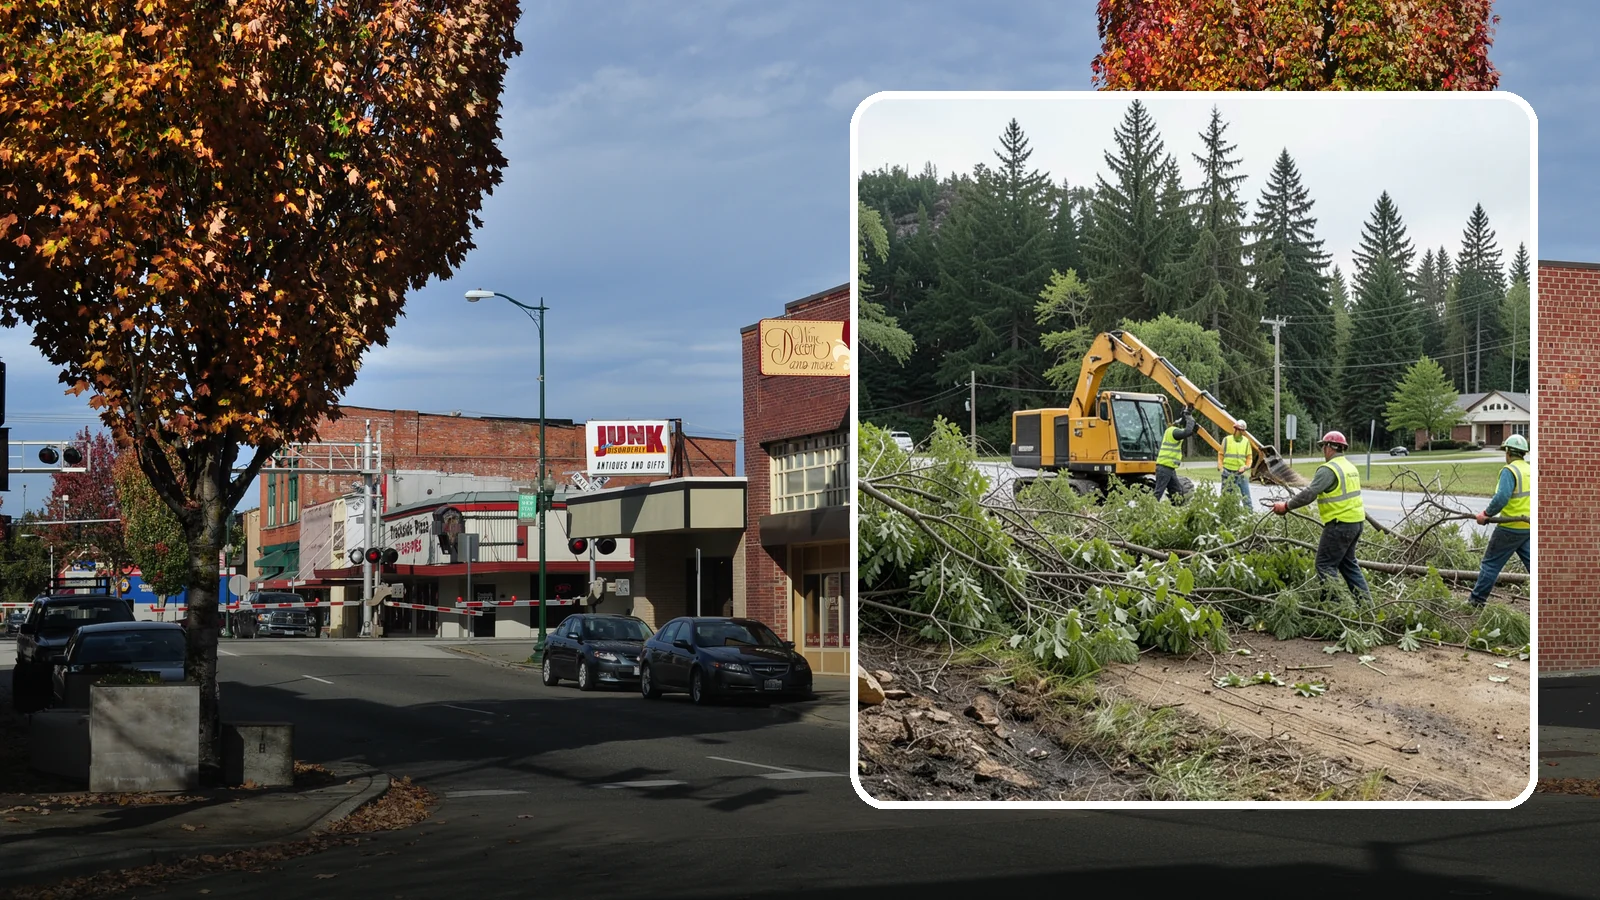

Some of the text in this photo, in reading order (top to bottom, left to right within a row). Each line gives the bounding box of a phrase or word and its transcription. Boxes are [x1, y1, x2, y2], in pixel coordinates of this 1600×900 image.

[595, 425, 665, 457] JUNK
[607, 446, 645, 454] DISORDERLY
[597, 460, 665, 470] ANTIQUES AND GIFTS
[573, 473, 588, 491] RAIL
[414, 519, 429, 534] Pizza
